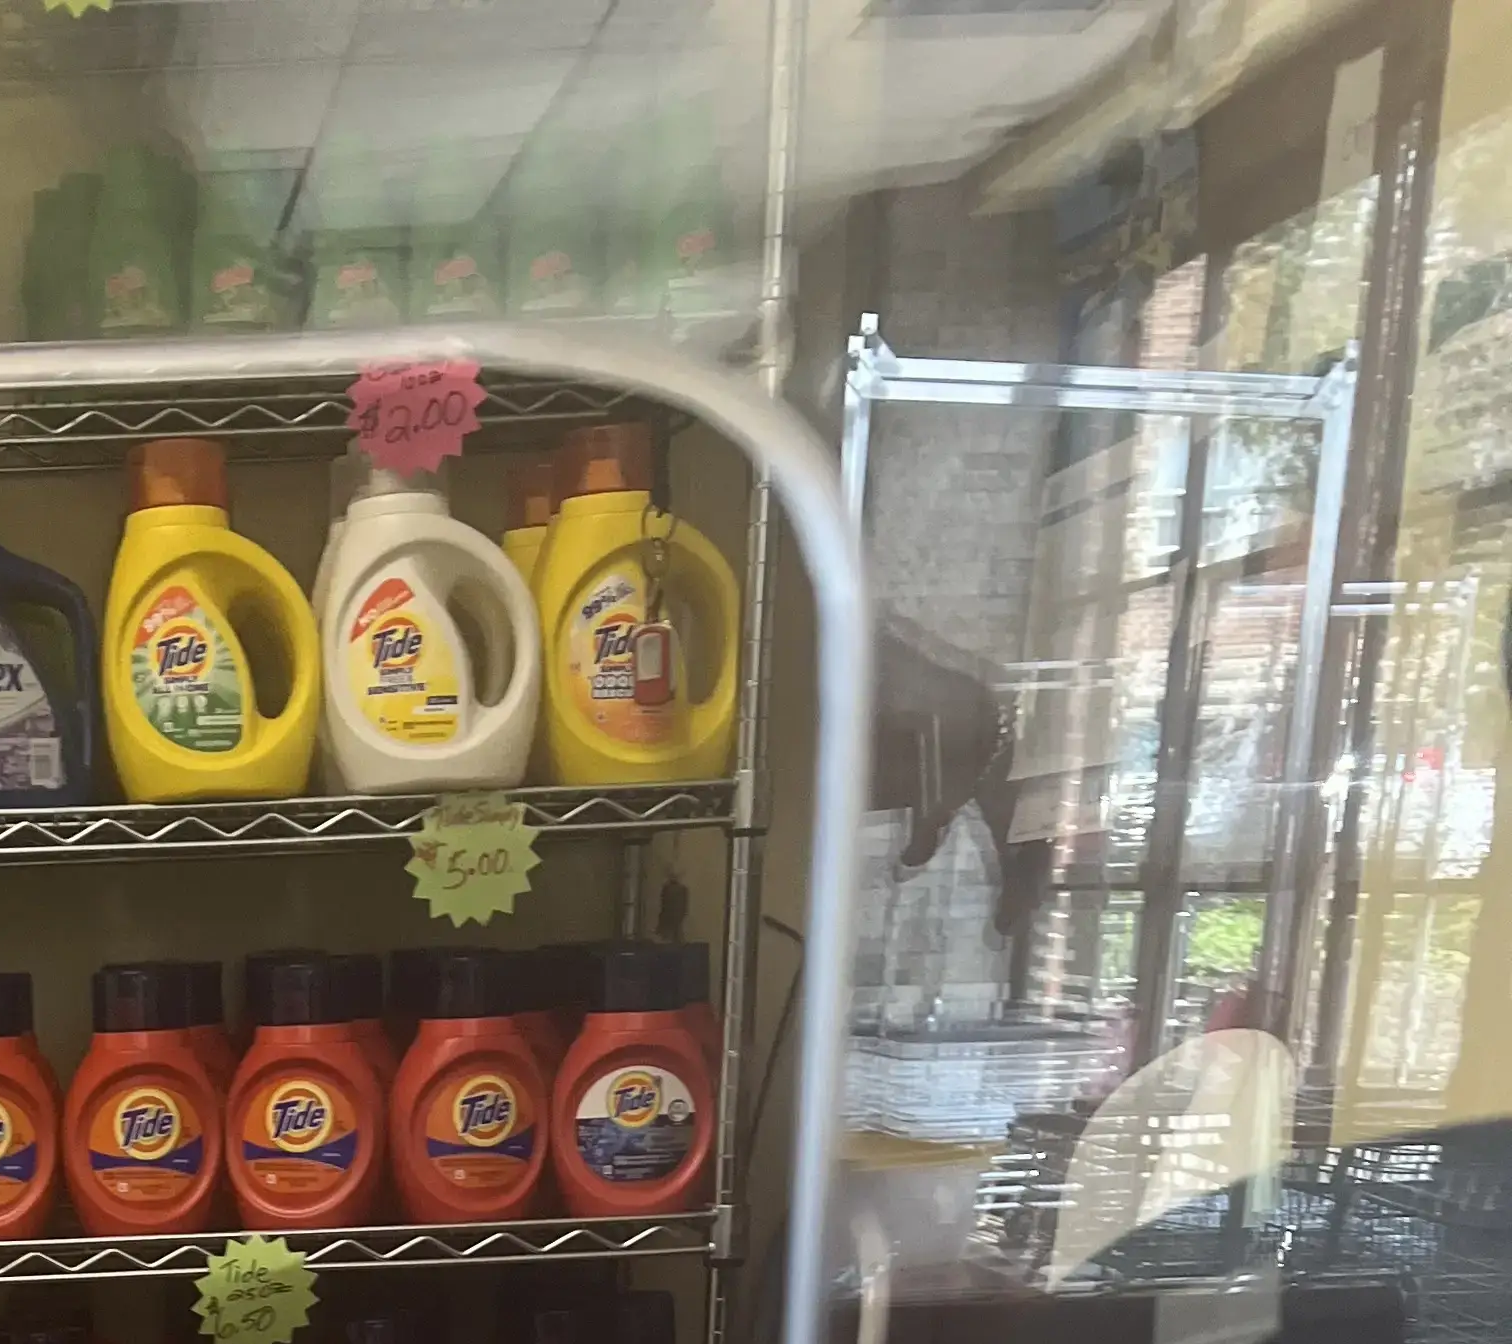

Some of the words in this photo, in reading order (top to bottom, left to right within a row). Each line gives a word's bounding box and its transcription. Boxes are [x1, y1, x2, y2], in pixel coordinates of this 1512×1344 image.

[358, 390, 468, 444] $2.00
[155, 636, 208, 677] Tide
[372, 627, 424, 668] Tide
[594, 624, 635, 664] Tid
[272, 1100, 326, 1140] Tide
[459, 1092, 512, 1136] Tide
[613, 1085, 657, 1119] Tide
[120, 1105, 174, 1150] Tide
[219, 1259, 272, 1284] Tide
